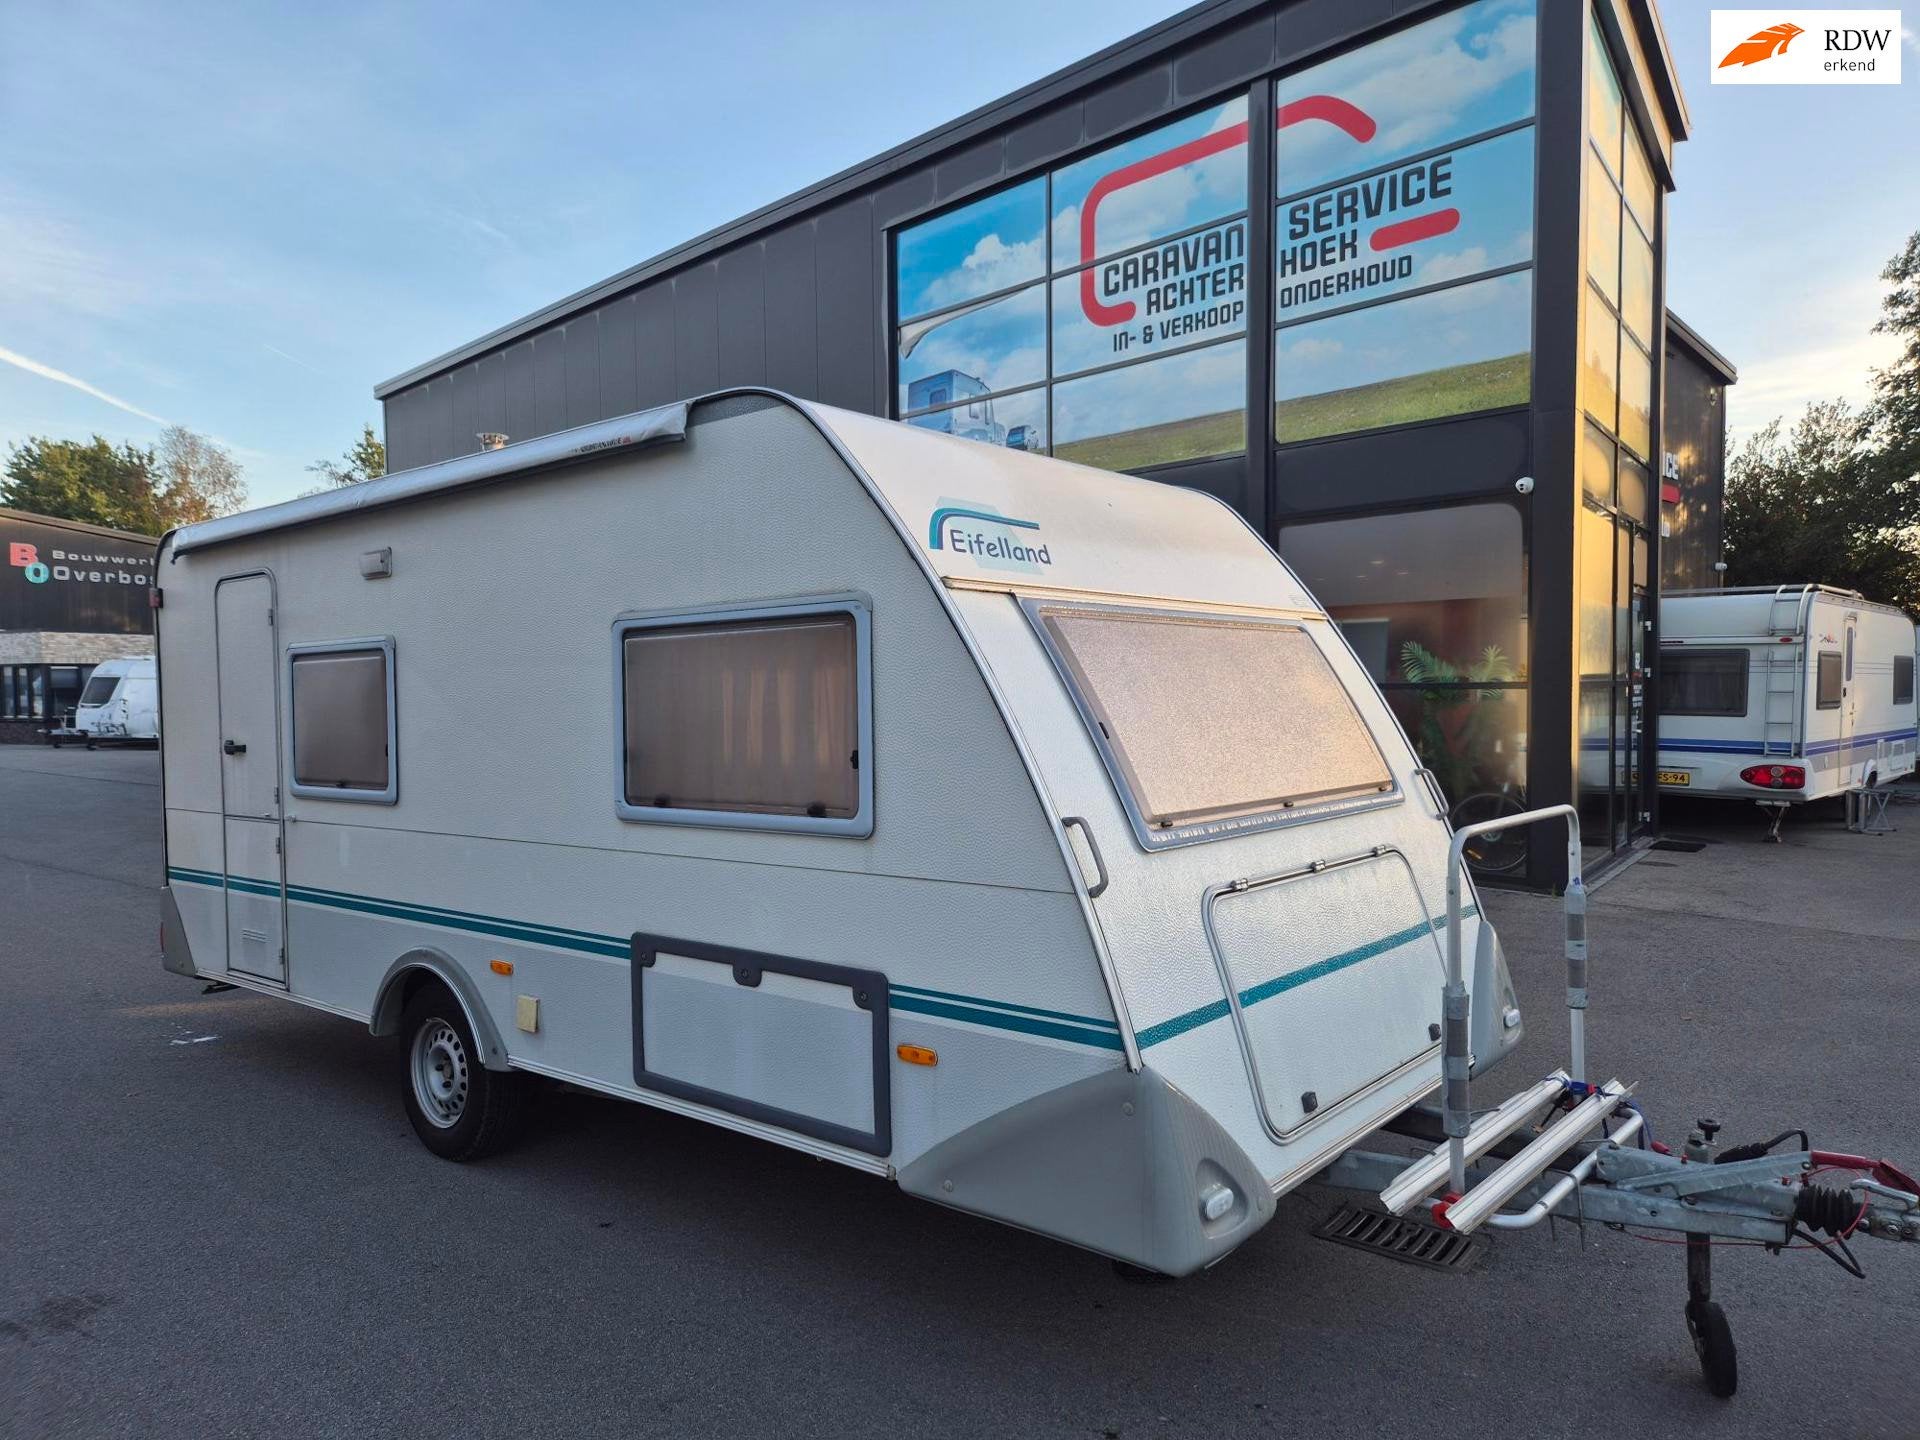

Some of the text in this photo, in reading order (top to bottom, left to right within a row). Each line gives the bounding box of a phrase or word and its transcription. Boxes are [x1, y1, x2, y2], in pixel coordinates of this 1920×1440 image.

[1103, 154, 1453, 298] CARAVAN SERVICE
[1142, 324, 1154, 345] &
[1160, 300, 1245, 340] VERKOOP
[1280, 254, 1413, 309] ONDERHOUD
[1145, 228, 1358, 316] ACHTER HOEK
[949, 528, 1052, 566] Eifelland
